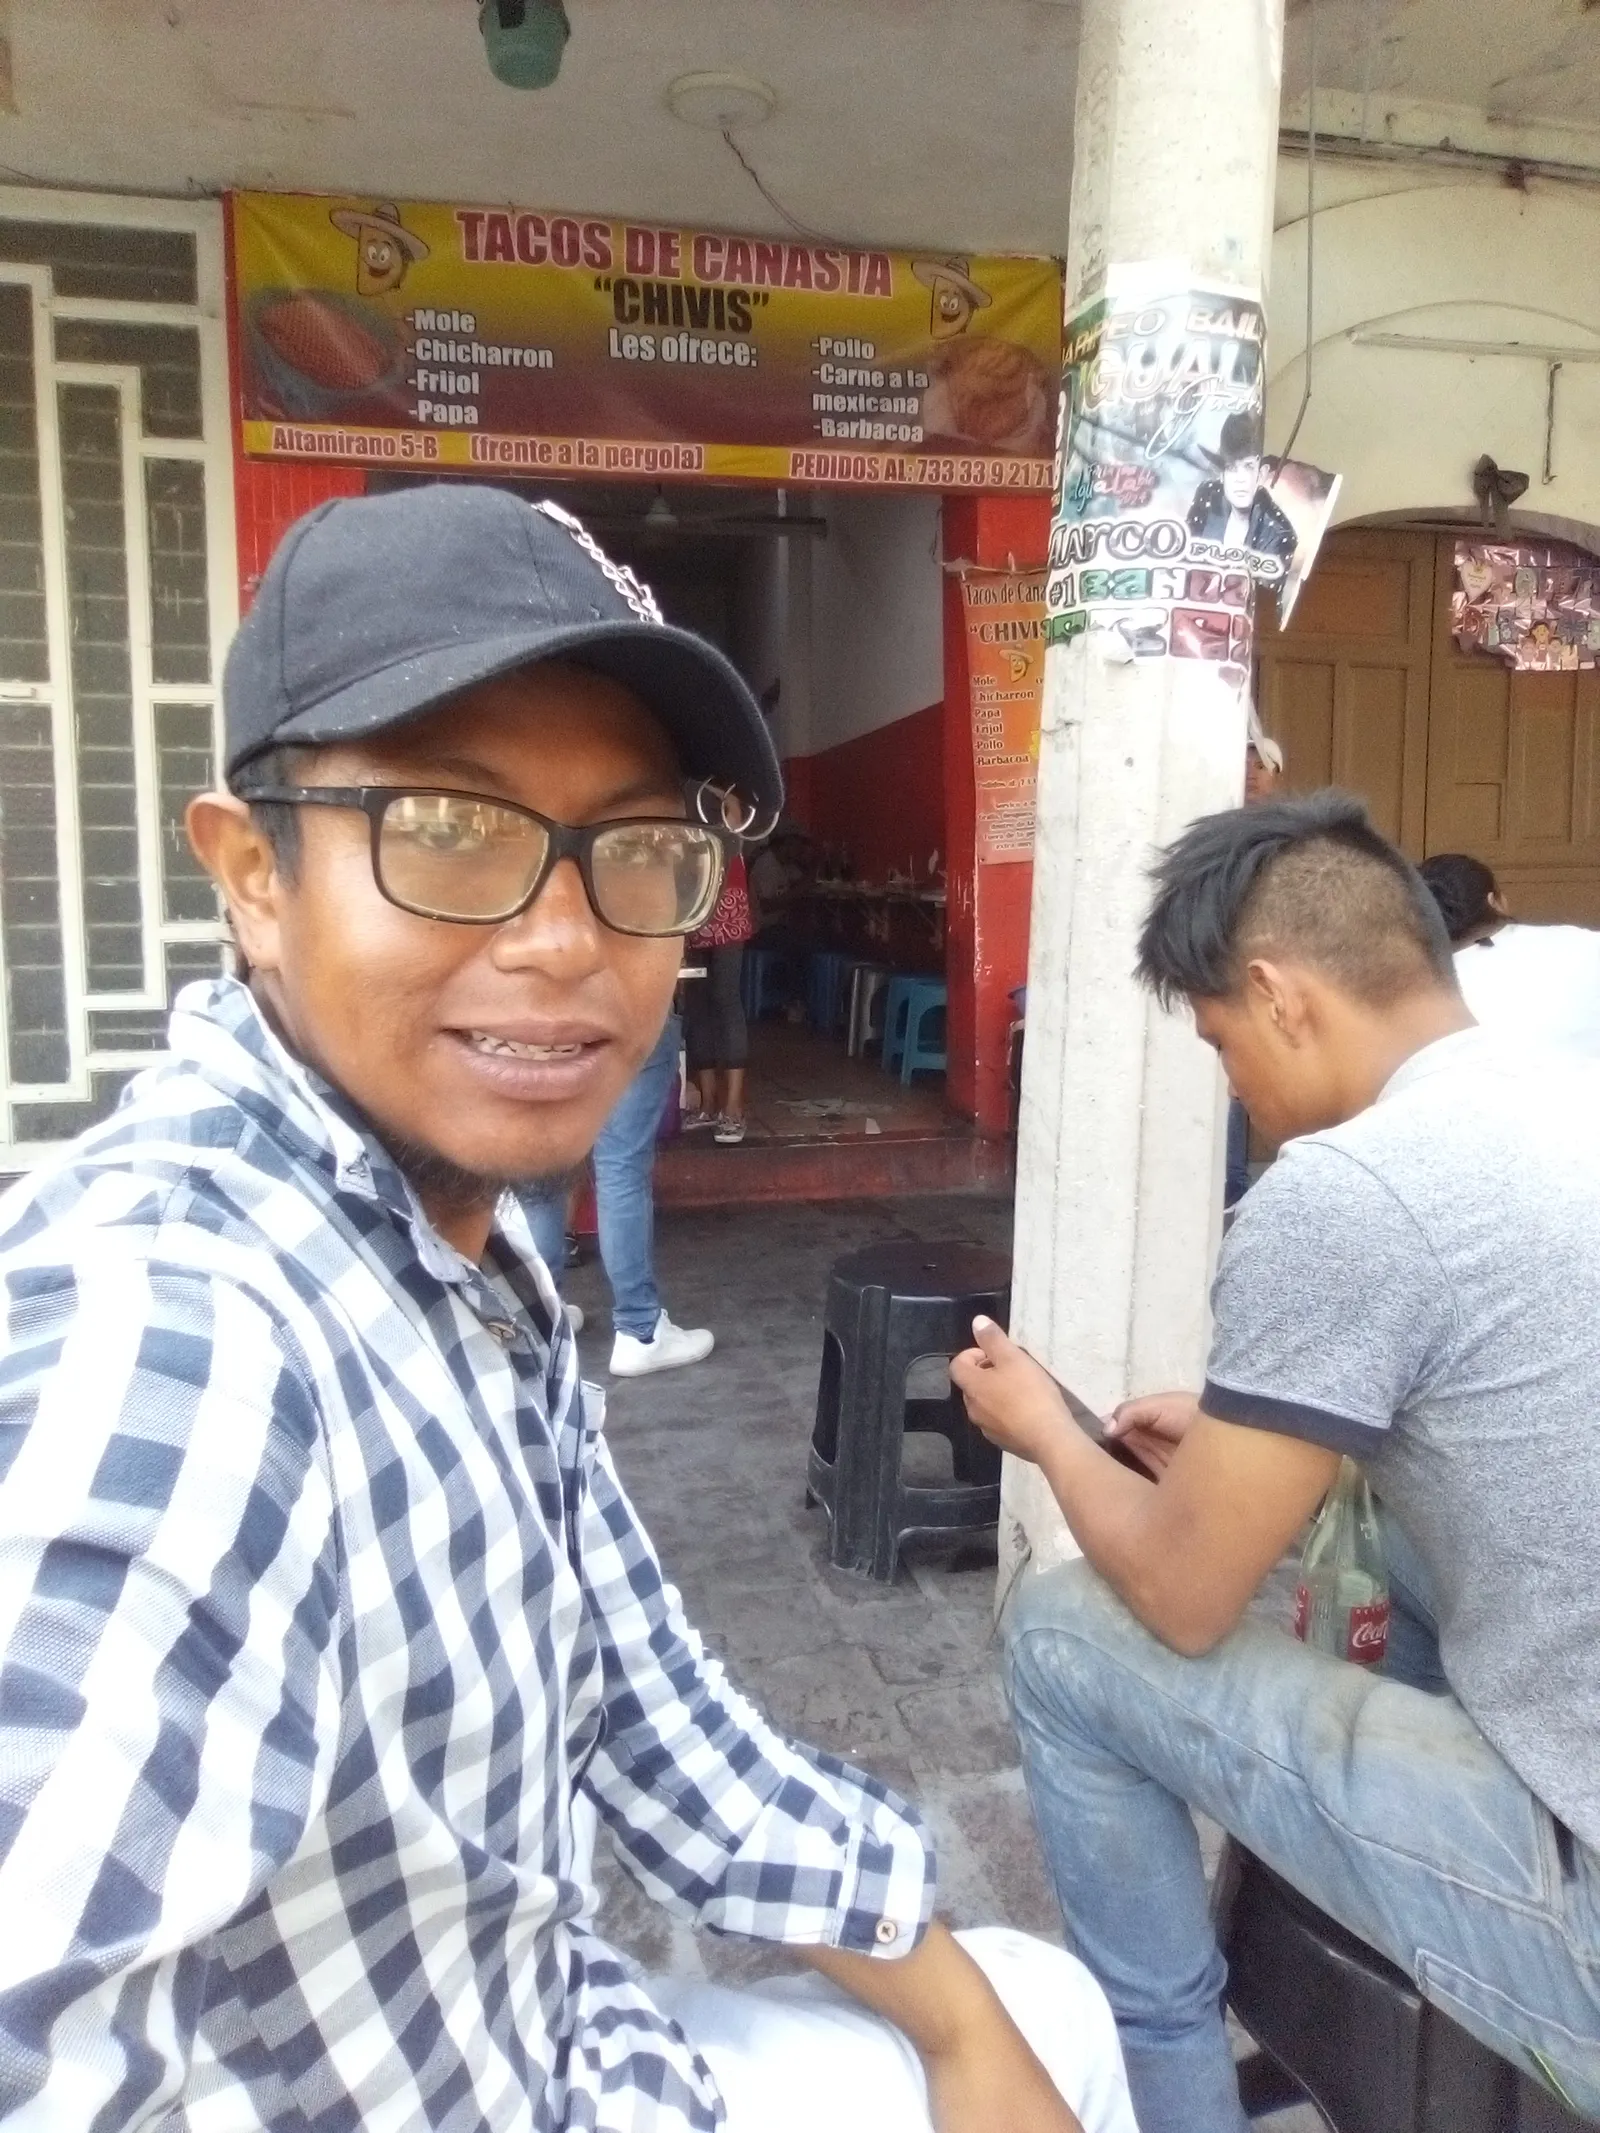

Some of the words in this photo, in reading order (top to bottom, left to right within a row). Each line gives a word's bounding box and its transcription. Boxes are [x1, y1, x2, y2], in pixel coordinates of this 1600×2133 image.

[455, 210, 613, 271] TACOS
[624, 226, 681, 279] DE
[693, 233, 893, 298] CANASTA
[594, 276, 769, 333] "CHIVIS"
[405, 309, 476, 333] -Mole
[1186, 306, 1263, 342] BAIL
[405, 338, 554, 368] -Chicharron
[609, 327, 656, 362] Les
[661, 331, 758, 367] ofrece:
[811, 337, 876, 359] -Pollo
[406, 369, 480, 395] -Frijol
[811, 363, 884, 388] -Carne
[889, 372, 902, 388] a
[907, 370, 929, 388] la
[1080, 336, 1262, 412] IGUAL
[408, 400, 479, 425] -Papa
[812, 393, 919, 414] mexicana
[272, 426, 396, 457] Altamirano
[400, 433, 439, 460] 5-B
[813, 418, 923, 443] -Barbacoa
[470, 433, 552, 464] (frente
[558, 443, 572, 465] a
[576, 440, 599, 467] la
[604, 443, 704, 473] pergola)
[790, 452, 879, 482] PEDIDOS
[884, 457, 913, 483] AL:
[917, 458, 954, 486] 733
[959, 459, 986, 486] 33
[990, 460, 1004, 486] 9
[1007, 461, 1053, 488] 2171
[965, 583, 998, 606] Tacos
[1001, 582, 1014, 604] de
